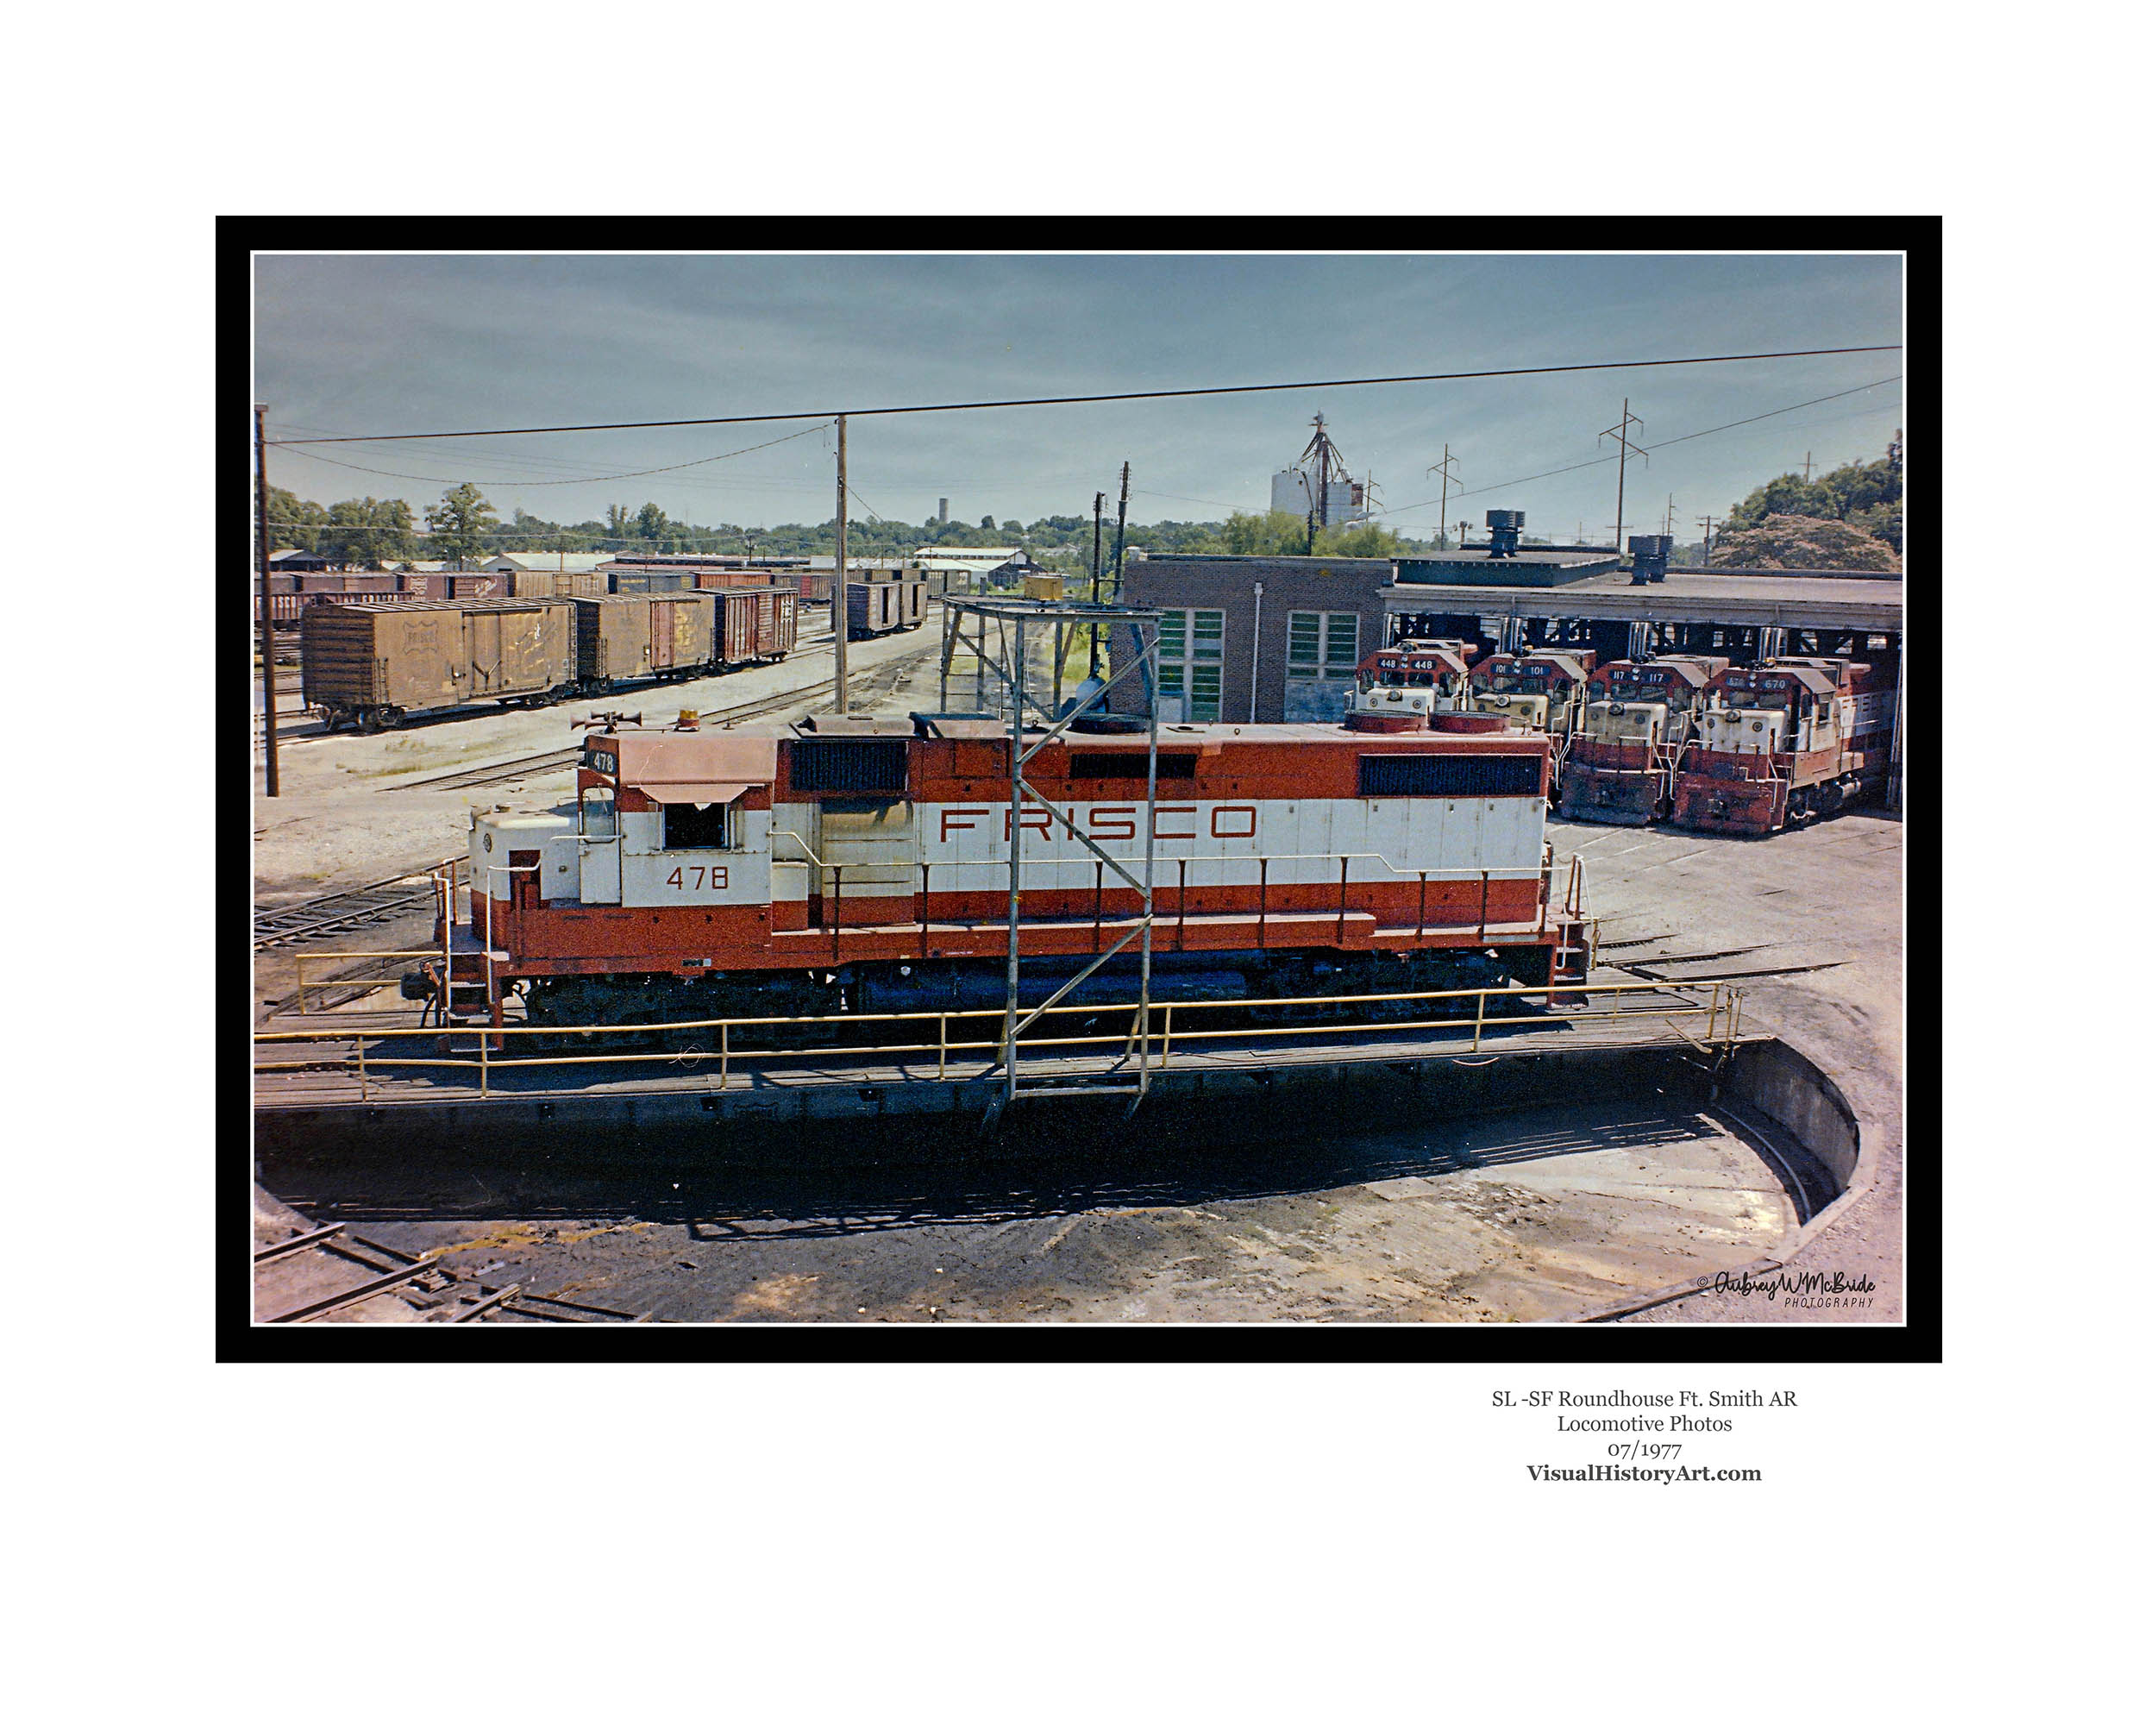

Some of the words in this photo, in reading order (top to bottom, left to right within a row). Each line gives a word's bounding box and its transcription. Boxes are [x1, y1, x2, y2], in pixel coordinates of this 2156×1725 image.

[256, 596, 297, 608] FISCO
[1380, 658, 1396, 668] 448
[1414, 660, 1433, 670] 448
[1495, 662, 1507, 674] 101
[1531, 666, 1544, 676] 101
[1614, 671, 1625, 681] 117
[1649, 673, 1664, 683] 117
[1765, 679, 1786, 690] 670
[594, 752, 614, 772] 478
[940, 806, 1257, 843] FRISCO
[666, 866, 729, 890] 478
